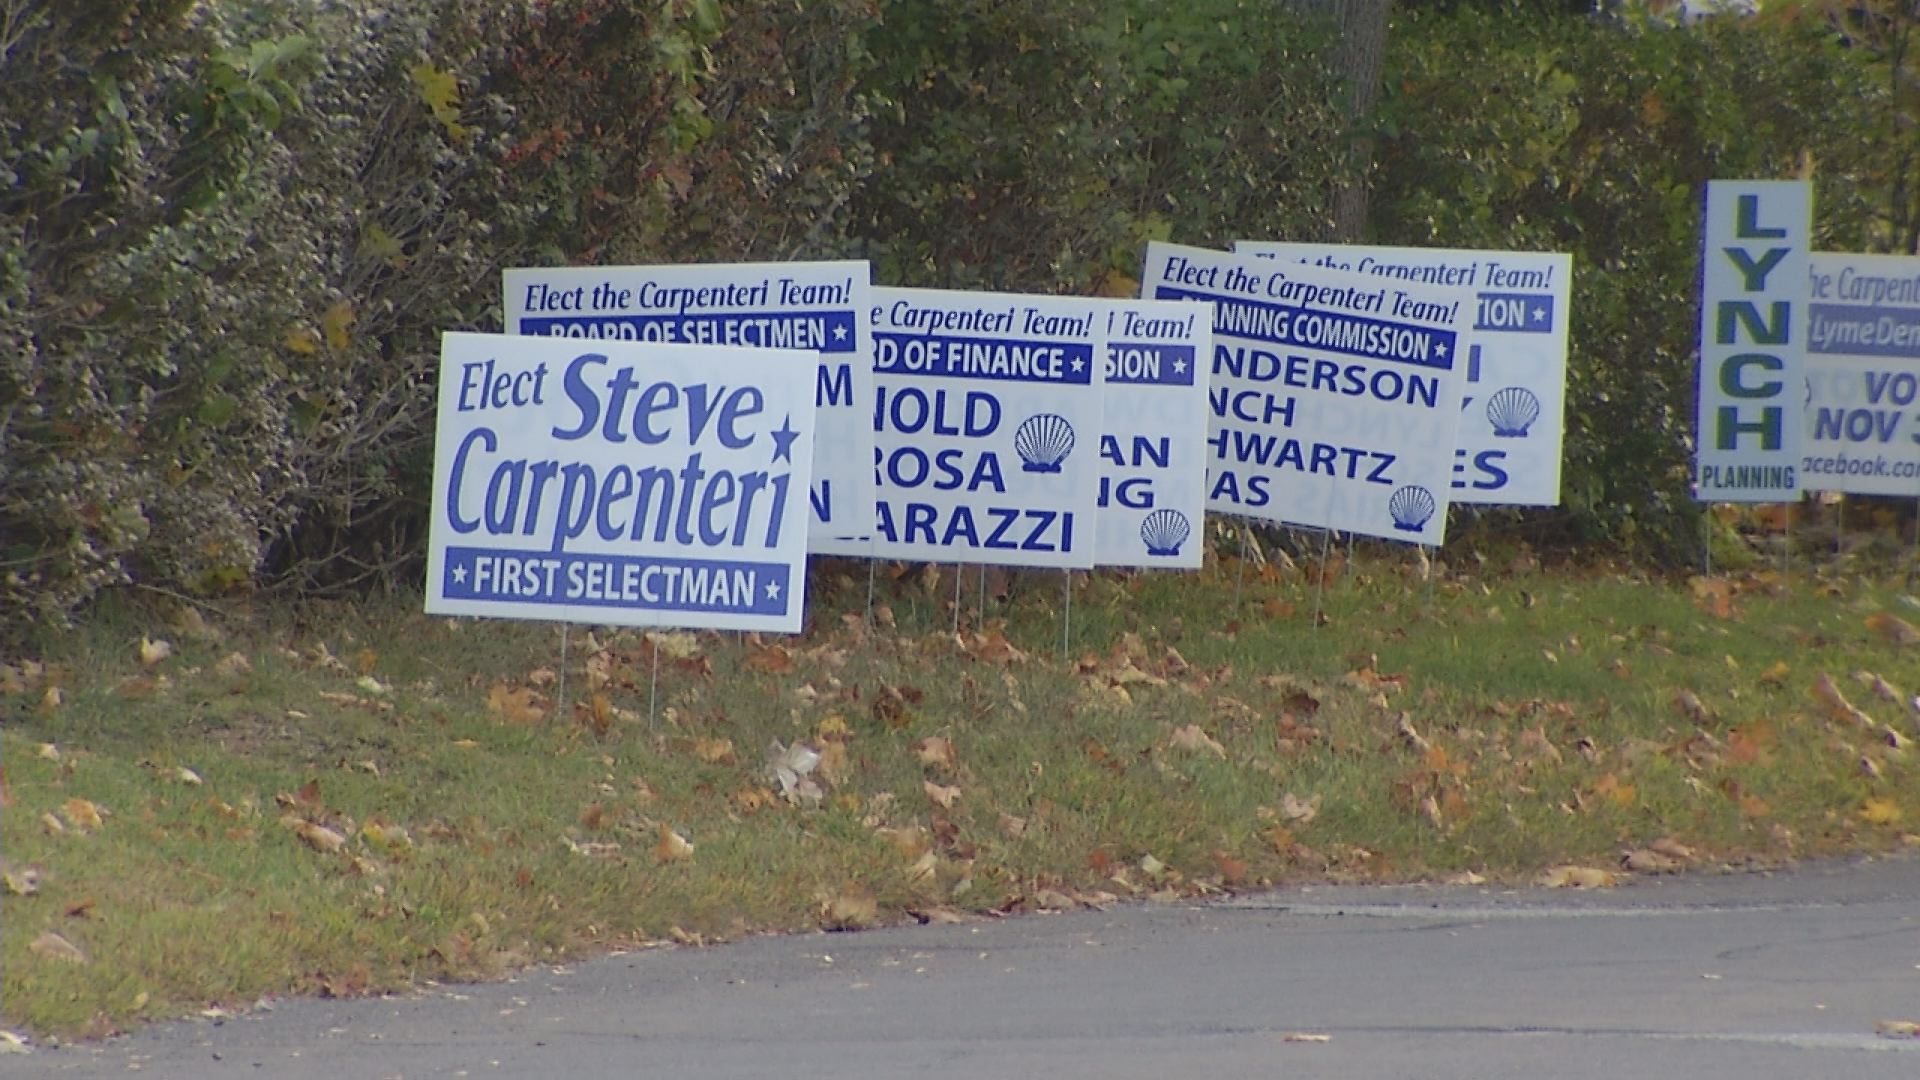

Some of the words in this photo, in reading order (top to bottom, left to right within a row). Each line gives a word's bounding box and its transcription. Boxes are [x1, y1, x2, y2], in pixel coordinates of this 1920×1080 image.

[1163, 257, 1219, 288] Elect
[1224, 266, 1261, 294] the
[1267, 272, 1385, 311] Carpenteri
[1391, 291, 1459, 324] Team!
[1485, 263, 1554, 289] Team!
[524, 284, 584, 311] Elect
[592, 282, 631, 308] the
[639, 279, 768, 316] Carpenteri
[778, 278, 852, 305] Team!
[1480, 300, 1525, 327] ION
[643, 321, 676, 343] OF
[681, 317, 825, 349] SELECTMEN
[891, 300, 1014, 336] Carpenteri
[1023, 307, 1093, 337] Team!
[1123, 311, 1194, 339] Team!
[1293, 310, 1431, 361] COMMISSION
[1716, 195, 1791, 450] LYNCH
[874, 339, 898, 369] D
[904, 340, 941, 370] OF
[948, 343, 1064, 378] FINANCE
[1104, 349, 1160, 379] SION
[1212, 344, 1439, 408] NDERSON
[458, 359, 548, 412] Elect
[552, 353, 763, 449] Steve
[1209, 386, 1296, 427] NCH
[1815, 408, 1902, 443] NOV
[874, 446, 1006, 493] OSA
[1100, 434, 1170, 468] AN
[1207, 429, 1396, 485] HWARTZ
[1803, 453, 1920, 477] acebook.co
[447, 424, 792, 551] Carpenteri
[1206, 468, 1271, 506] AS
[1703, 466, 1795, 489] PLANNING
[876, 501, 1073, 552] ARAZZI
[473, 557, 562, 598] FIRST
[567, 563, 756, 606] SELECTMAN
